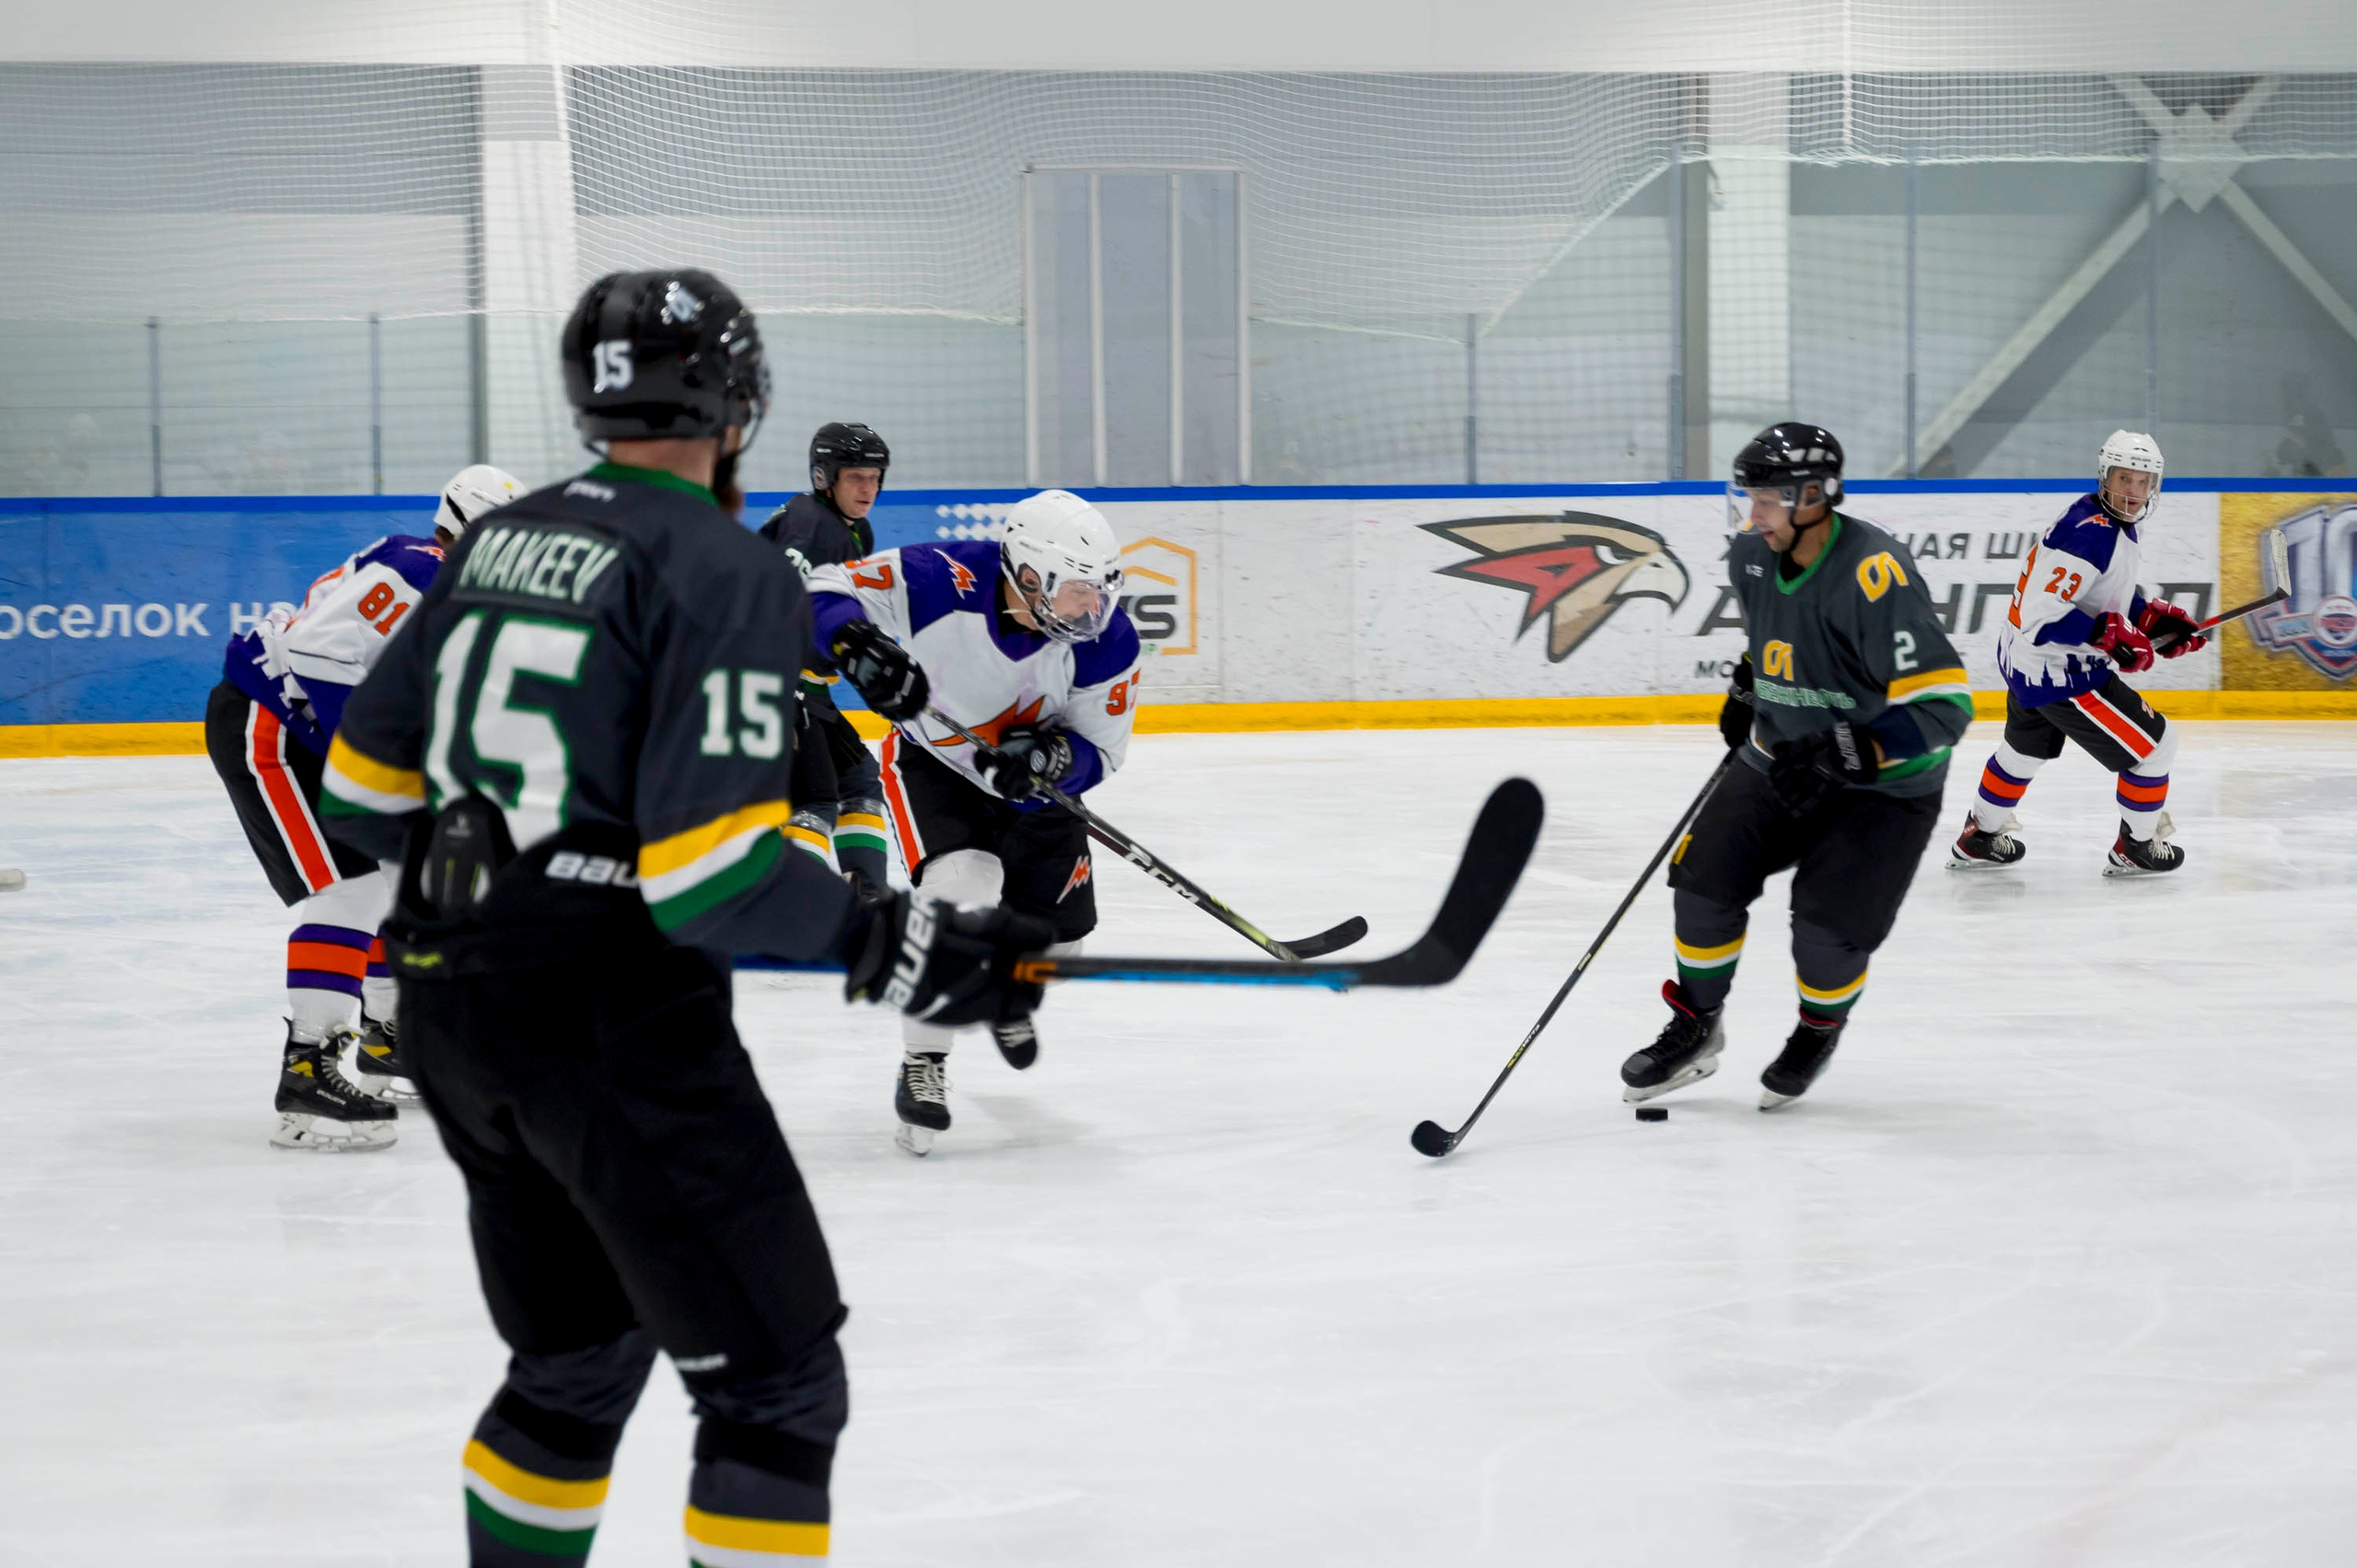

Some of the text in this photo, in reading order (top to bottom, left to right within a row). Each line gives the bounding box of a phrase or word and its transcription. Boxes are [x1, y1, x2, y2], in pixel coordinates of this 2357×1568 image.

[593, 339, 634, 390] 15
[459, 526, 620, 603] MAKEEV
[844, 559, 893, 590] 7
[2044, 566, 2083, 601] 23
[358, 582, 410, 636] 81
[1893, 631, 1919, 672] 2
[424, 609, 595, 854] 15
[700, 668, 784, 759] 15
